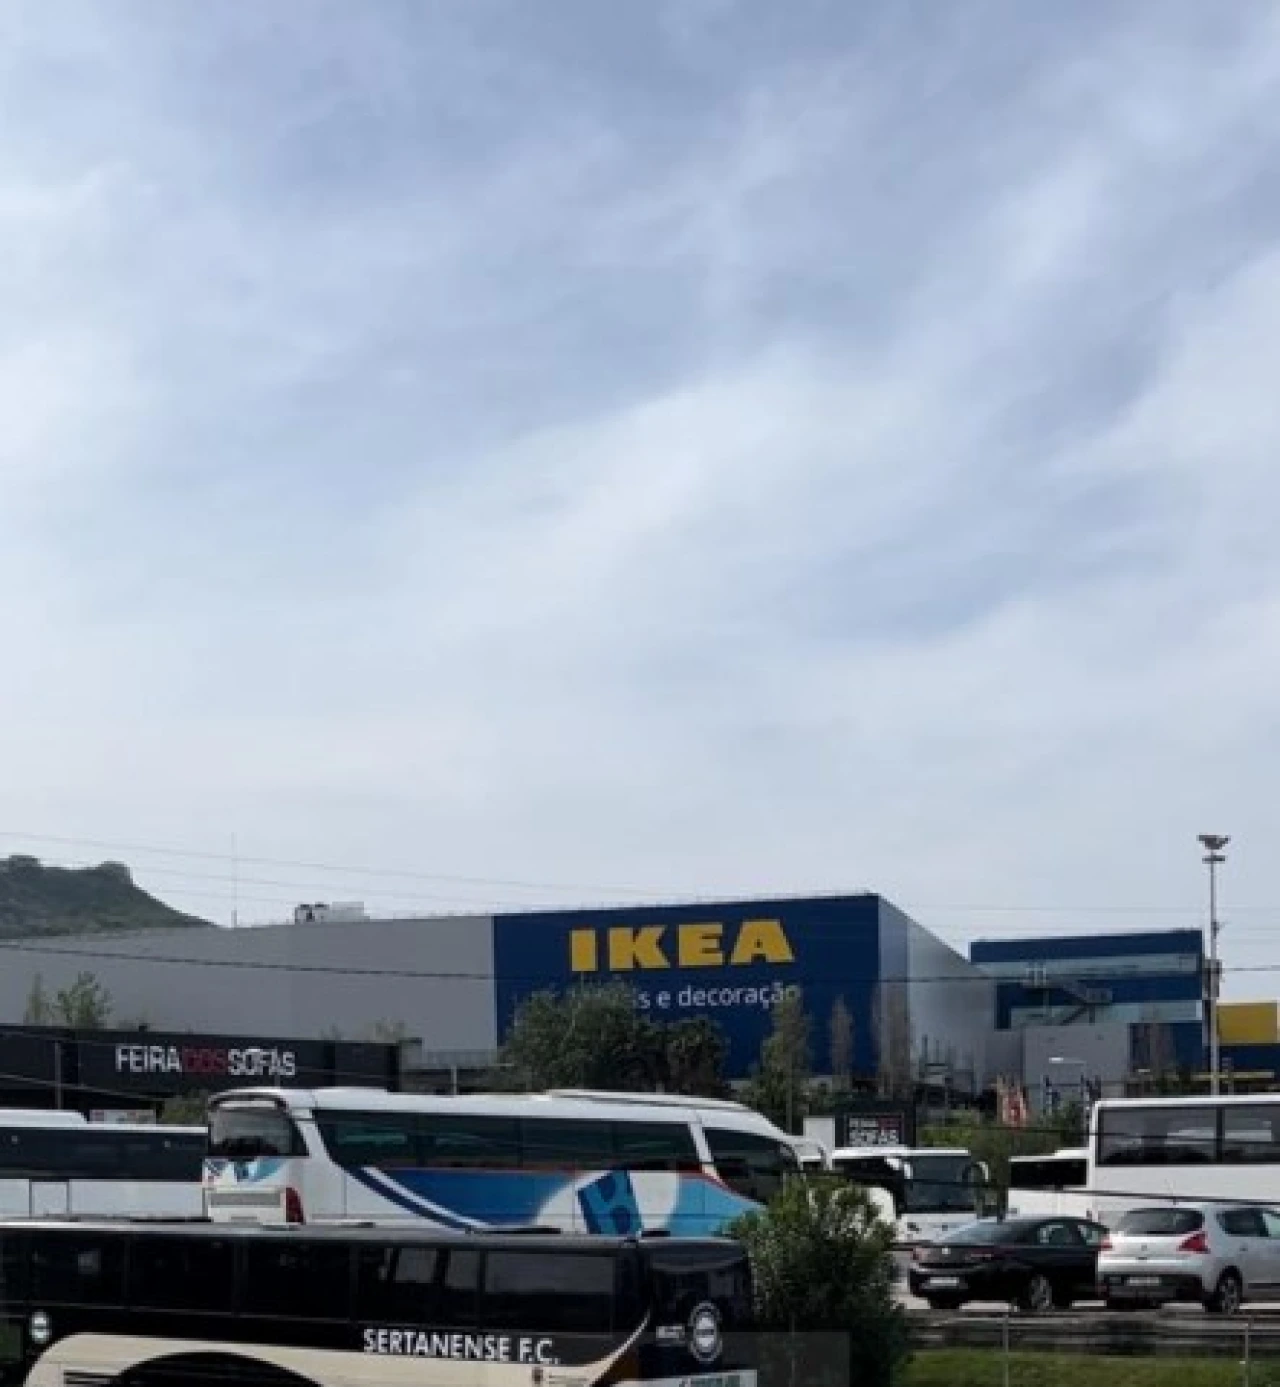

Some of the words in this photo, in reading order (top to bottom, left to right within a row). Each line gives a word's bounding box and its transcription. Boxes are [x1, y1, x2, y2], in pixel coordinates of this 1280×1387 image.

[570, 920, 796, 972] IKEA
[655, 990, 671, 1009] e
[363, 1327, 511, 1361] SERTANENSE
[519, 1337, 560, 1365] F.C.
